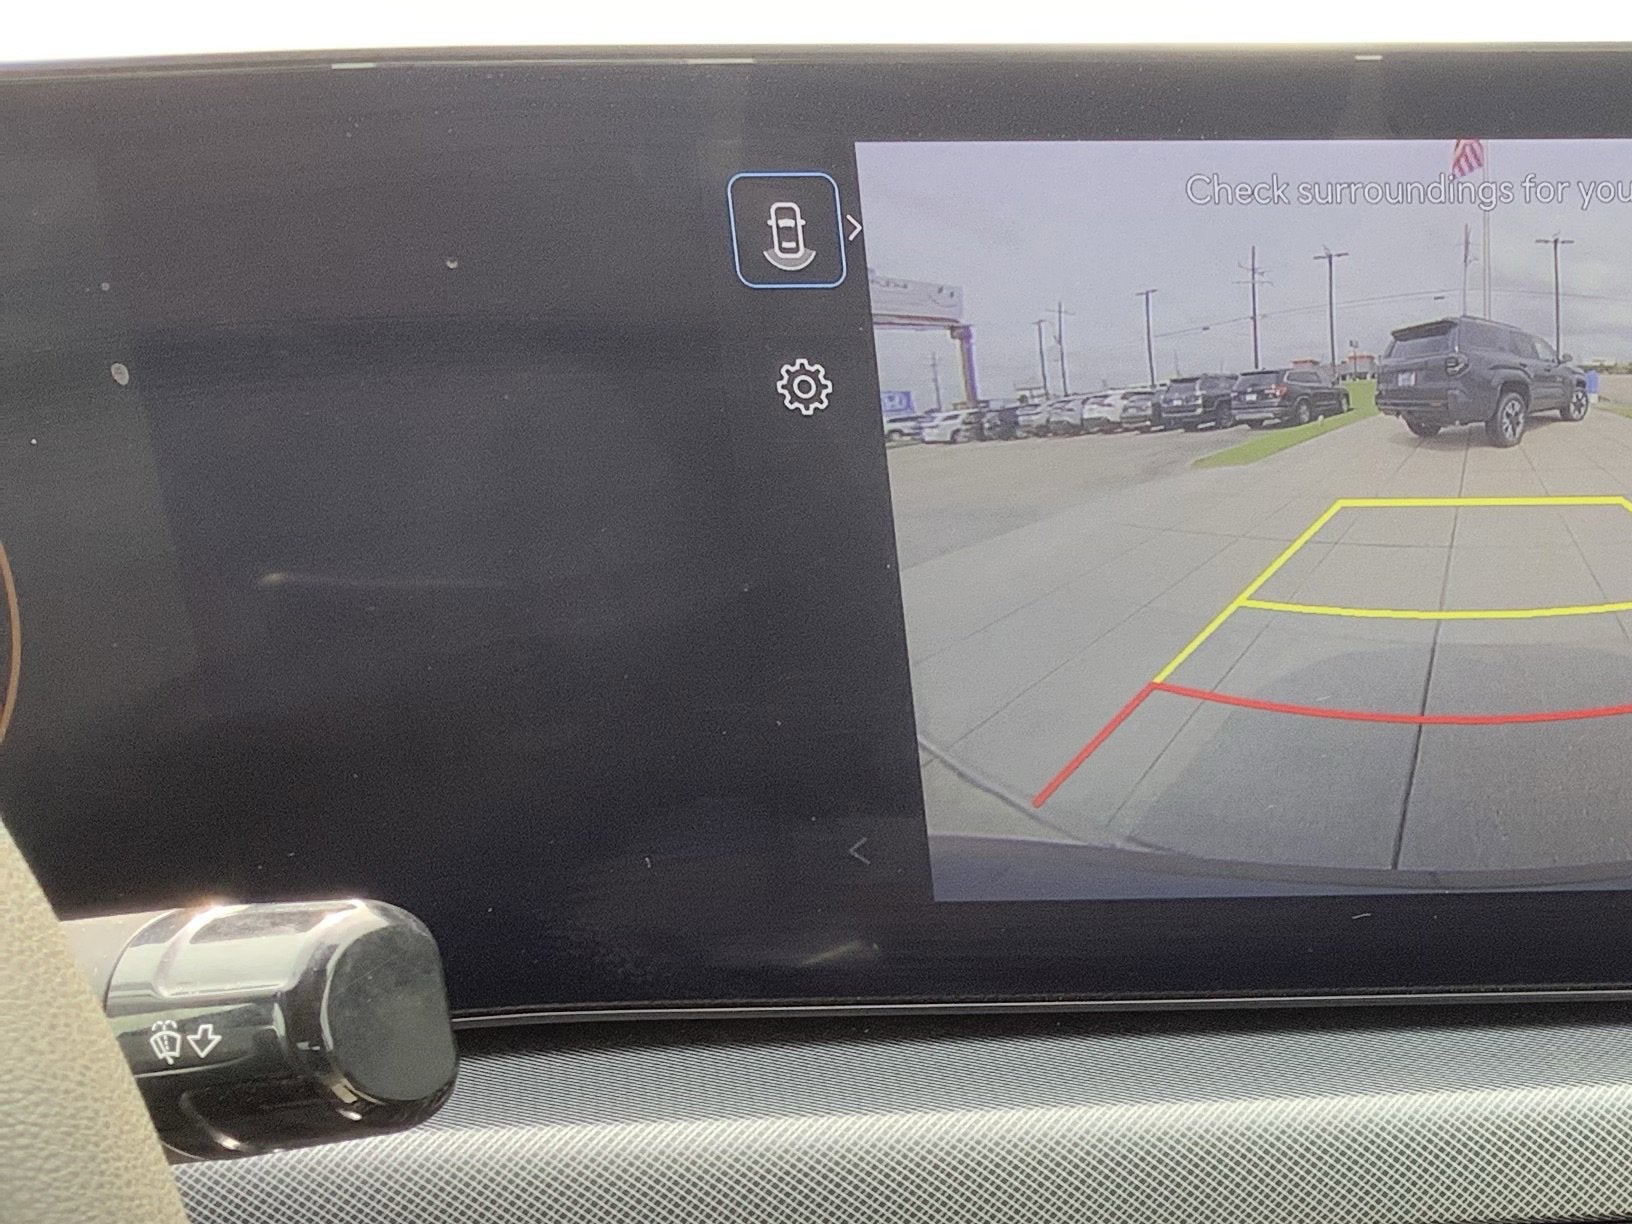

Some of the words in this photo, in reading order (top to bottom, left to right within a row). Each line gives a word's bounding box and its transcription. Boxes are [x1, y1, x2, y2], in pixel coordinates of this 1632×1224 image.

[1186, 173, 1290, 205] Check
[1298, 173, 1515, 211] surroundings
[1520, 172, 1570, 204] for
